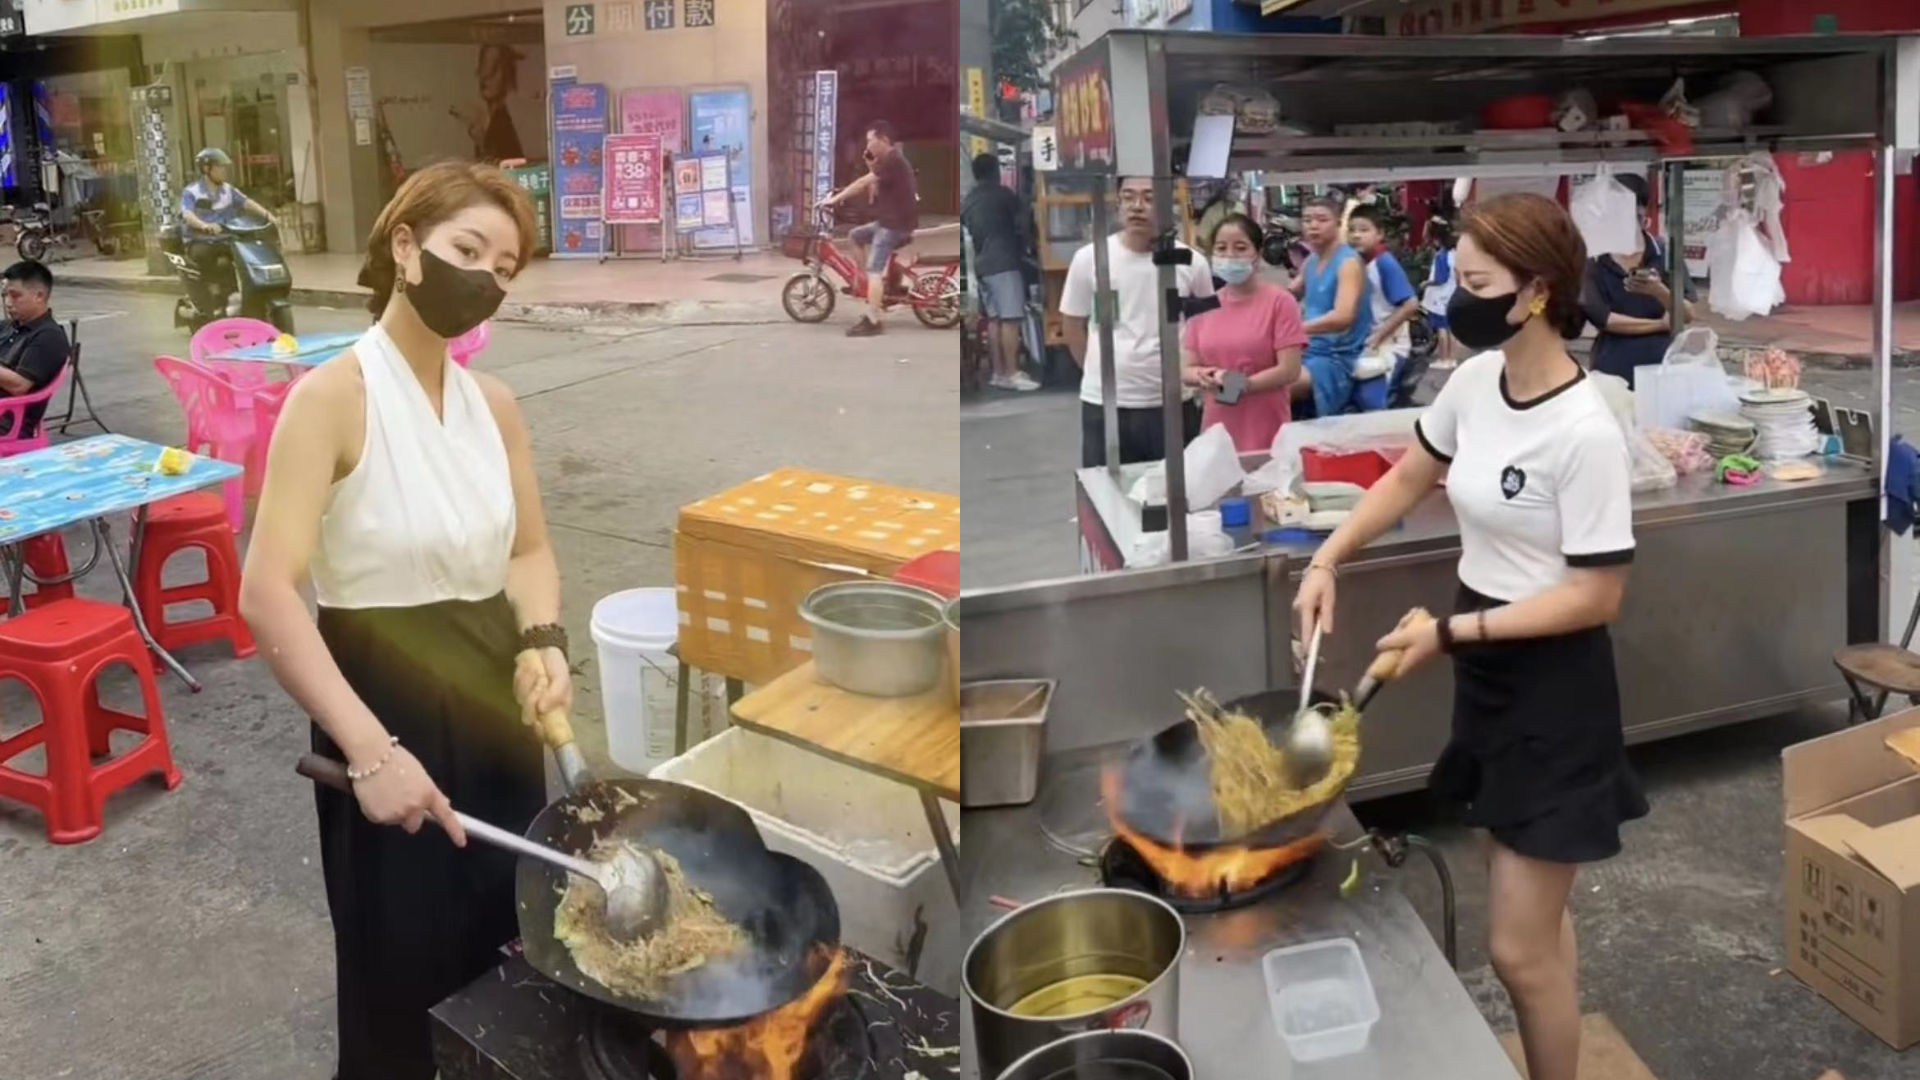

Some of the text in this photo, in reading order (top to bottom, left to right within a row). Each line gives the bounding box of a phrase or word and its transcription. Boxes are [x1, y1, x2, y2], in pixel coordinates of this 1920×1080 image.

[567, 0, 714, 34] 分期付款
[817, 80, 834, 203] 手机专业维
